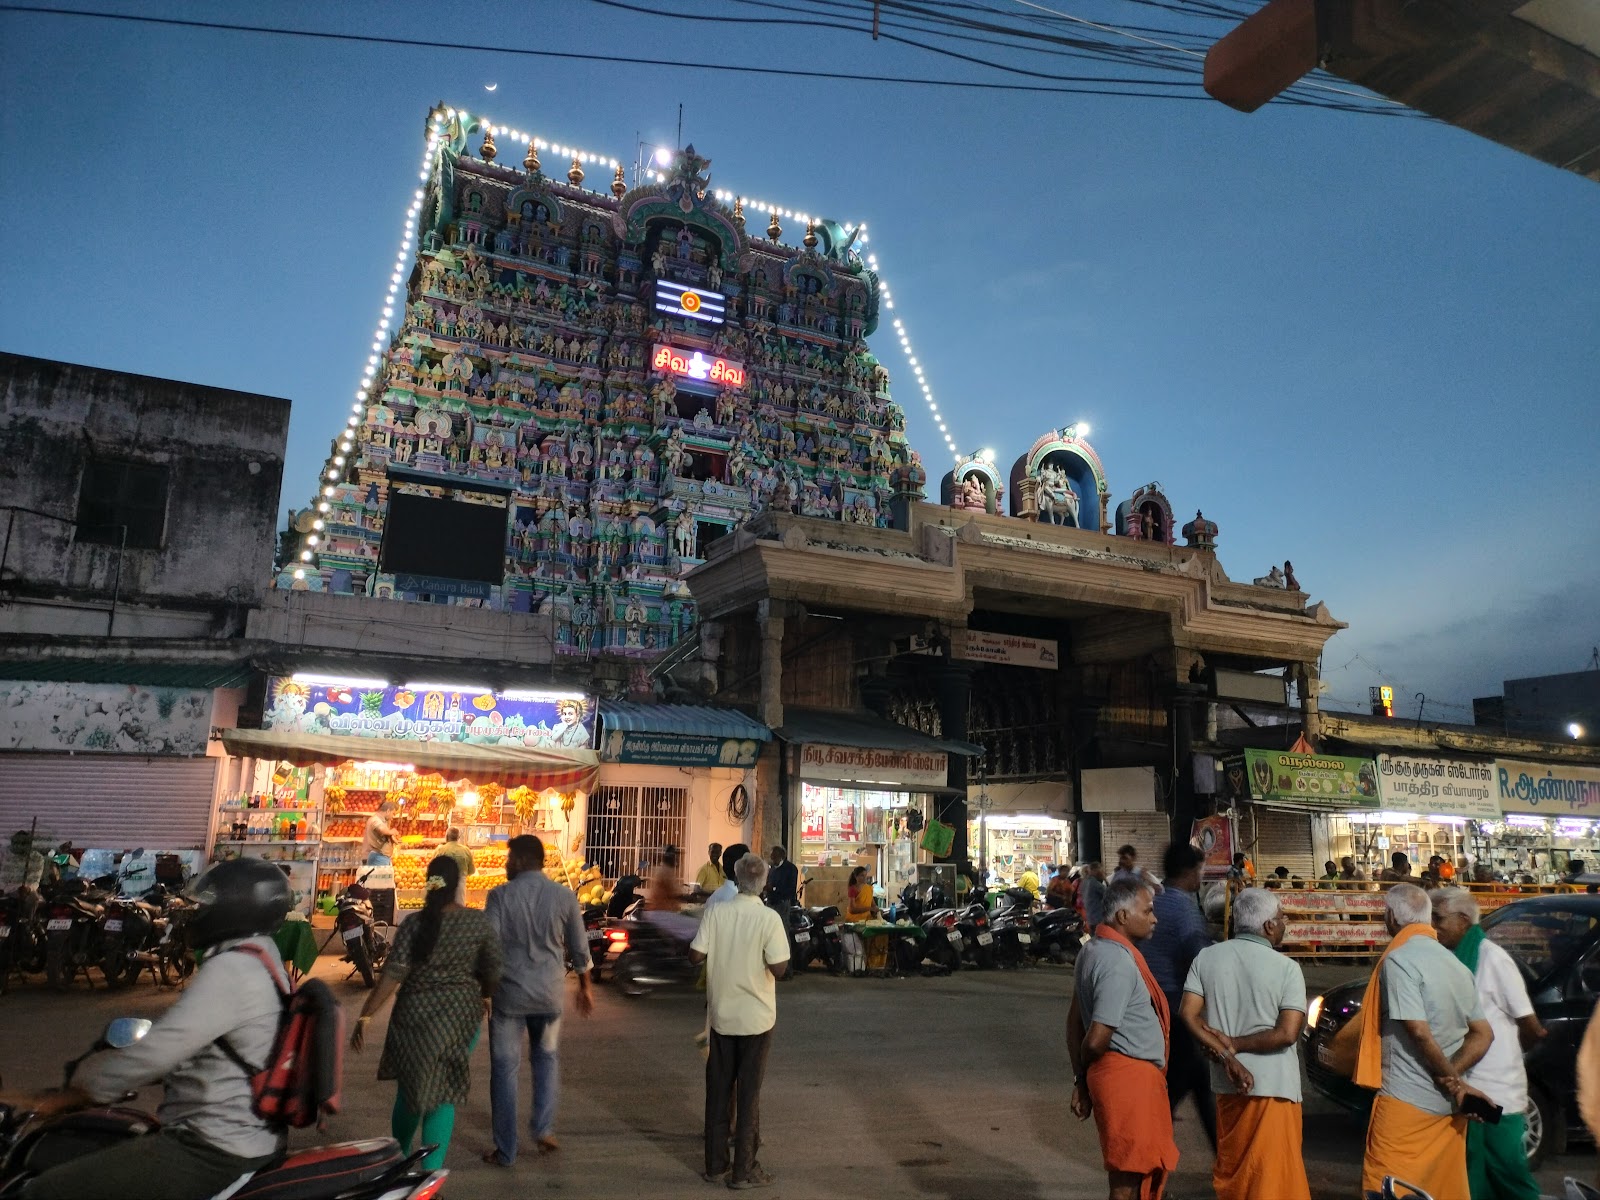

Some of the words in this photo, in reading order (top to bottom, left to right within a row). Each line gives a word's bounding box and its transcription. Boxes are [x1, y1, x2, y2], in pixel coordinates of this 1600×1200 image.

[654, 348, 688, 373] சிவ
[709, 360, 744, 385] சிவ
[421, 579, 457, 593] Canara
[460, 583, 485, 596] Bank
[329, 713, 392, 731] விஸ்வ
[394, 716, 462, 737] முருகன்
[802, 746, 825, 766] நியூ
[1278, 753, 1345, 771] நெல்லை
[1395, 761, 1412, 776] குரு
[1412, 761, 1446, 778] முருகன்
[1448, 760, 1492, 781] ஸ்டோர்ஸ்
[1393, 778, 1440, 798] பாத்திர
[1442, 783, 1490, 800] வியாபாரம்
[1498, 767, 1600, 811] R.ஆண்டிநா
